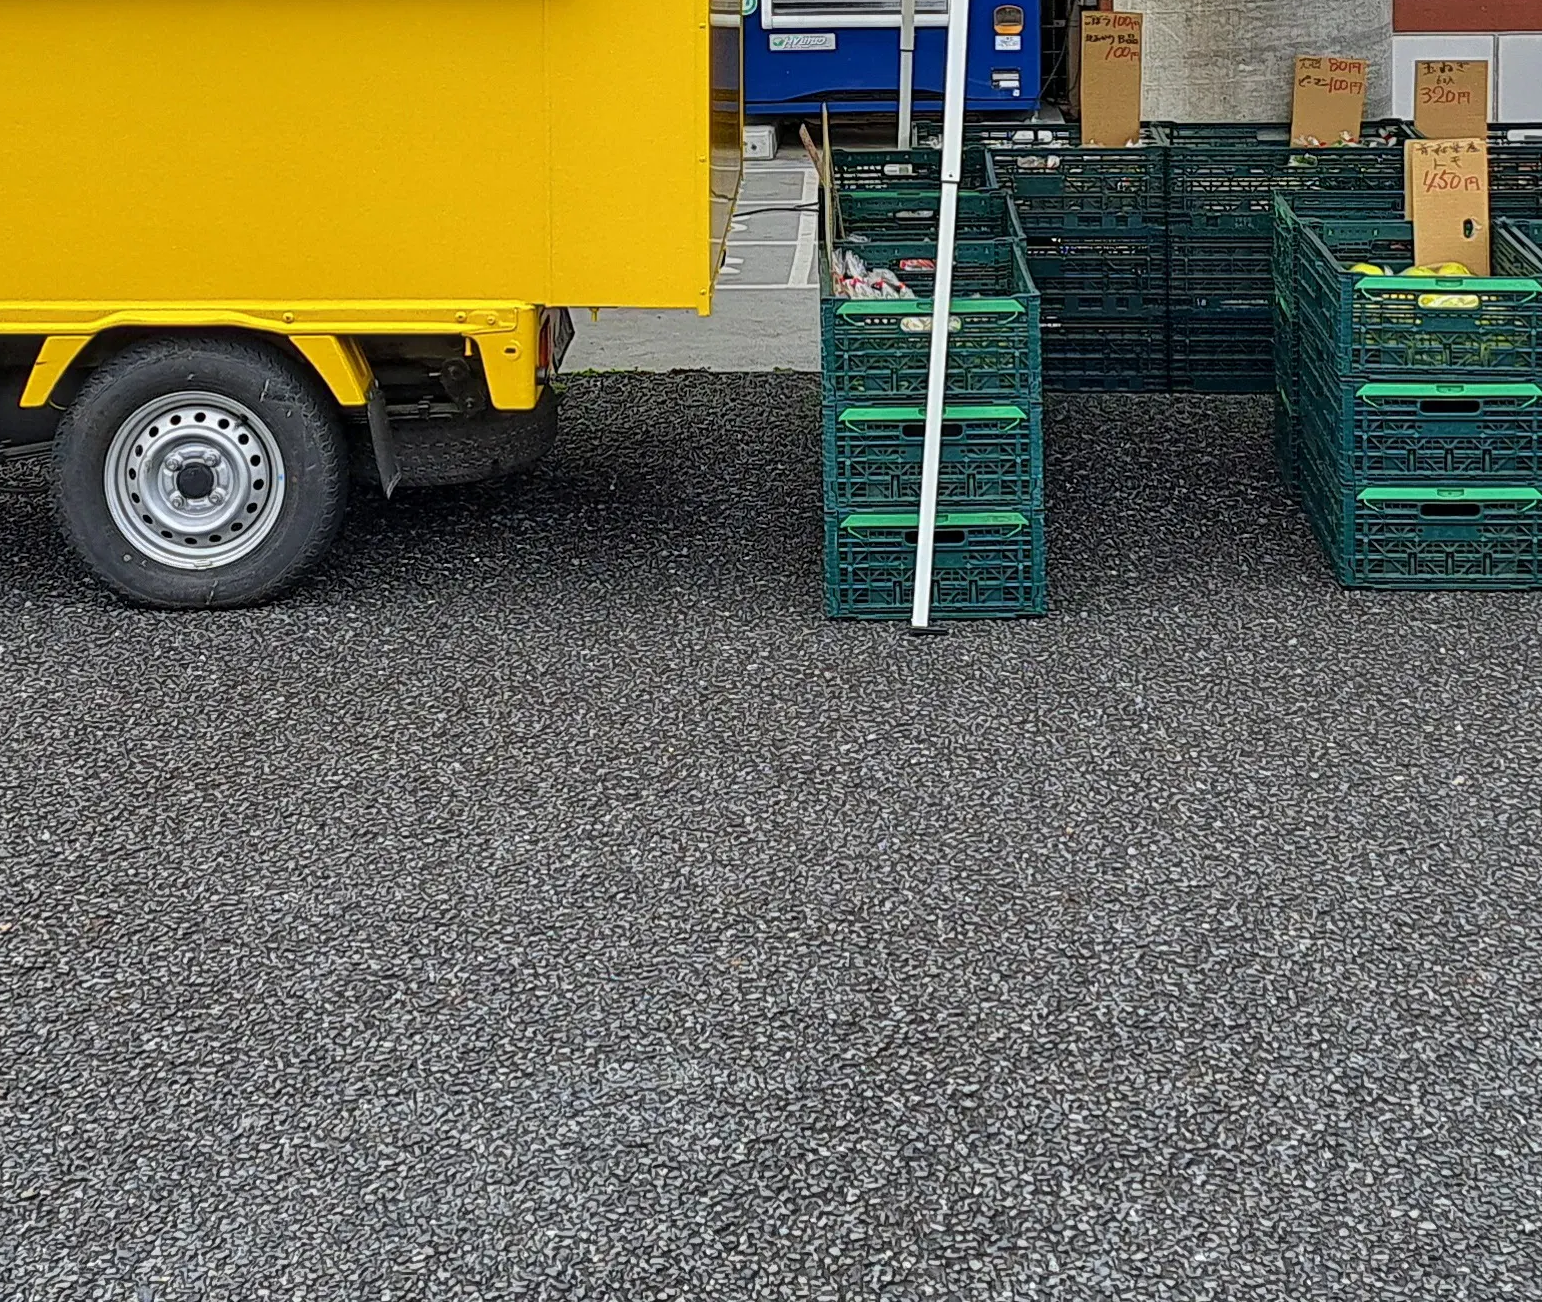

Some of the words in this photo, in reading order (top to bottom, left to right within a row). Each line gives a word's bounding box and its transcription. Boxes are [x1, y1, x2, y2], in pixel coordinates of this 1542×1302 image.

[1328, 58, 1362, 75] 80円
[1420, 85, 1471, 104] 320円
[1422, 169, 1481, 193] 450円
